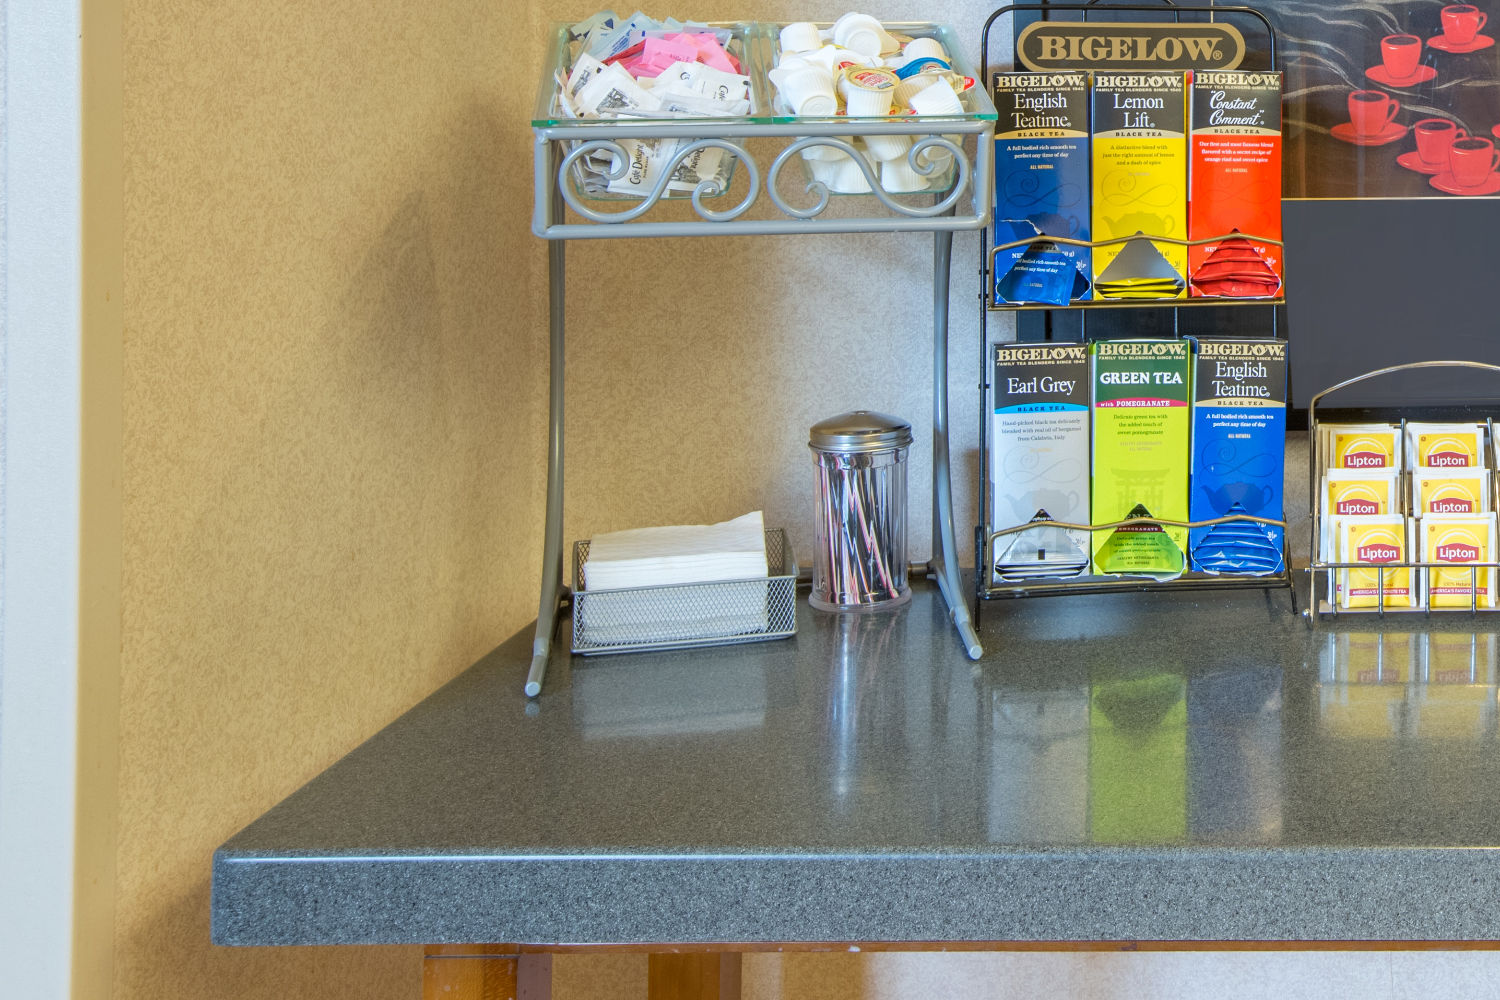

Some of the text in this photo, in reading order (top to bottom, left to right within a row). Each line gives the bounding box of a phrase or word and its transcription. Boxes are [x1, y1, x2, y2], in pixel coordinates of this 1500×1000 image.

[1014, 93, 1067, 112] English
[1113, 93, 1164, 109] Lemon
[632, 143, 645, 169] Delight
[1216, 361, 1267, 381] English
[1100, 372, 1183, 384] GREEN TEA
[1007, 376, 1076, 396] Earl Grey
[1347, 456, 1382, 468] Lipton
[1430, 456, 1465, 468] Lipton
[1340, 503, 1375, 515] Lipton
[1433, 502, 1469, 514] Lipton
[1361, 548, 1397, 560] Lipton
[1439, 547, 1475, 560] Lipton
